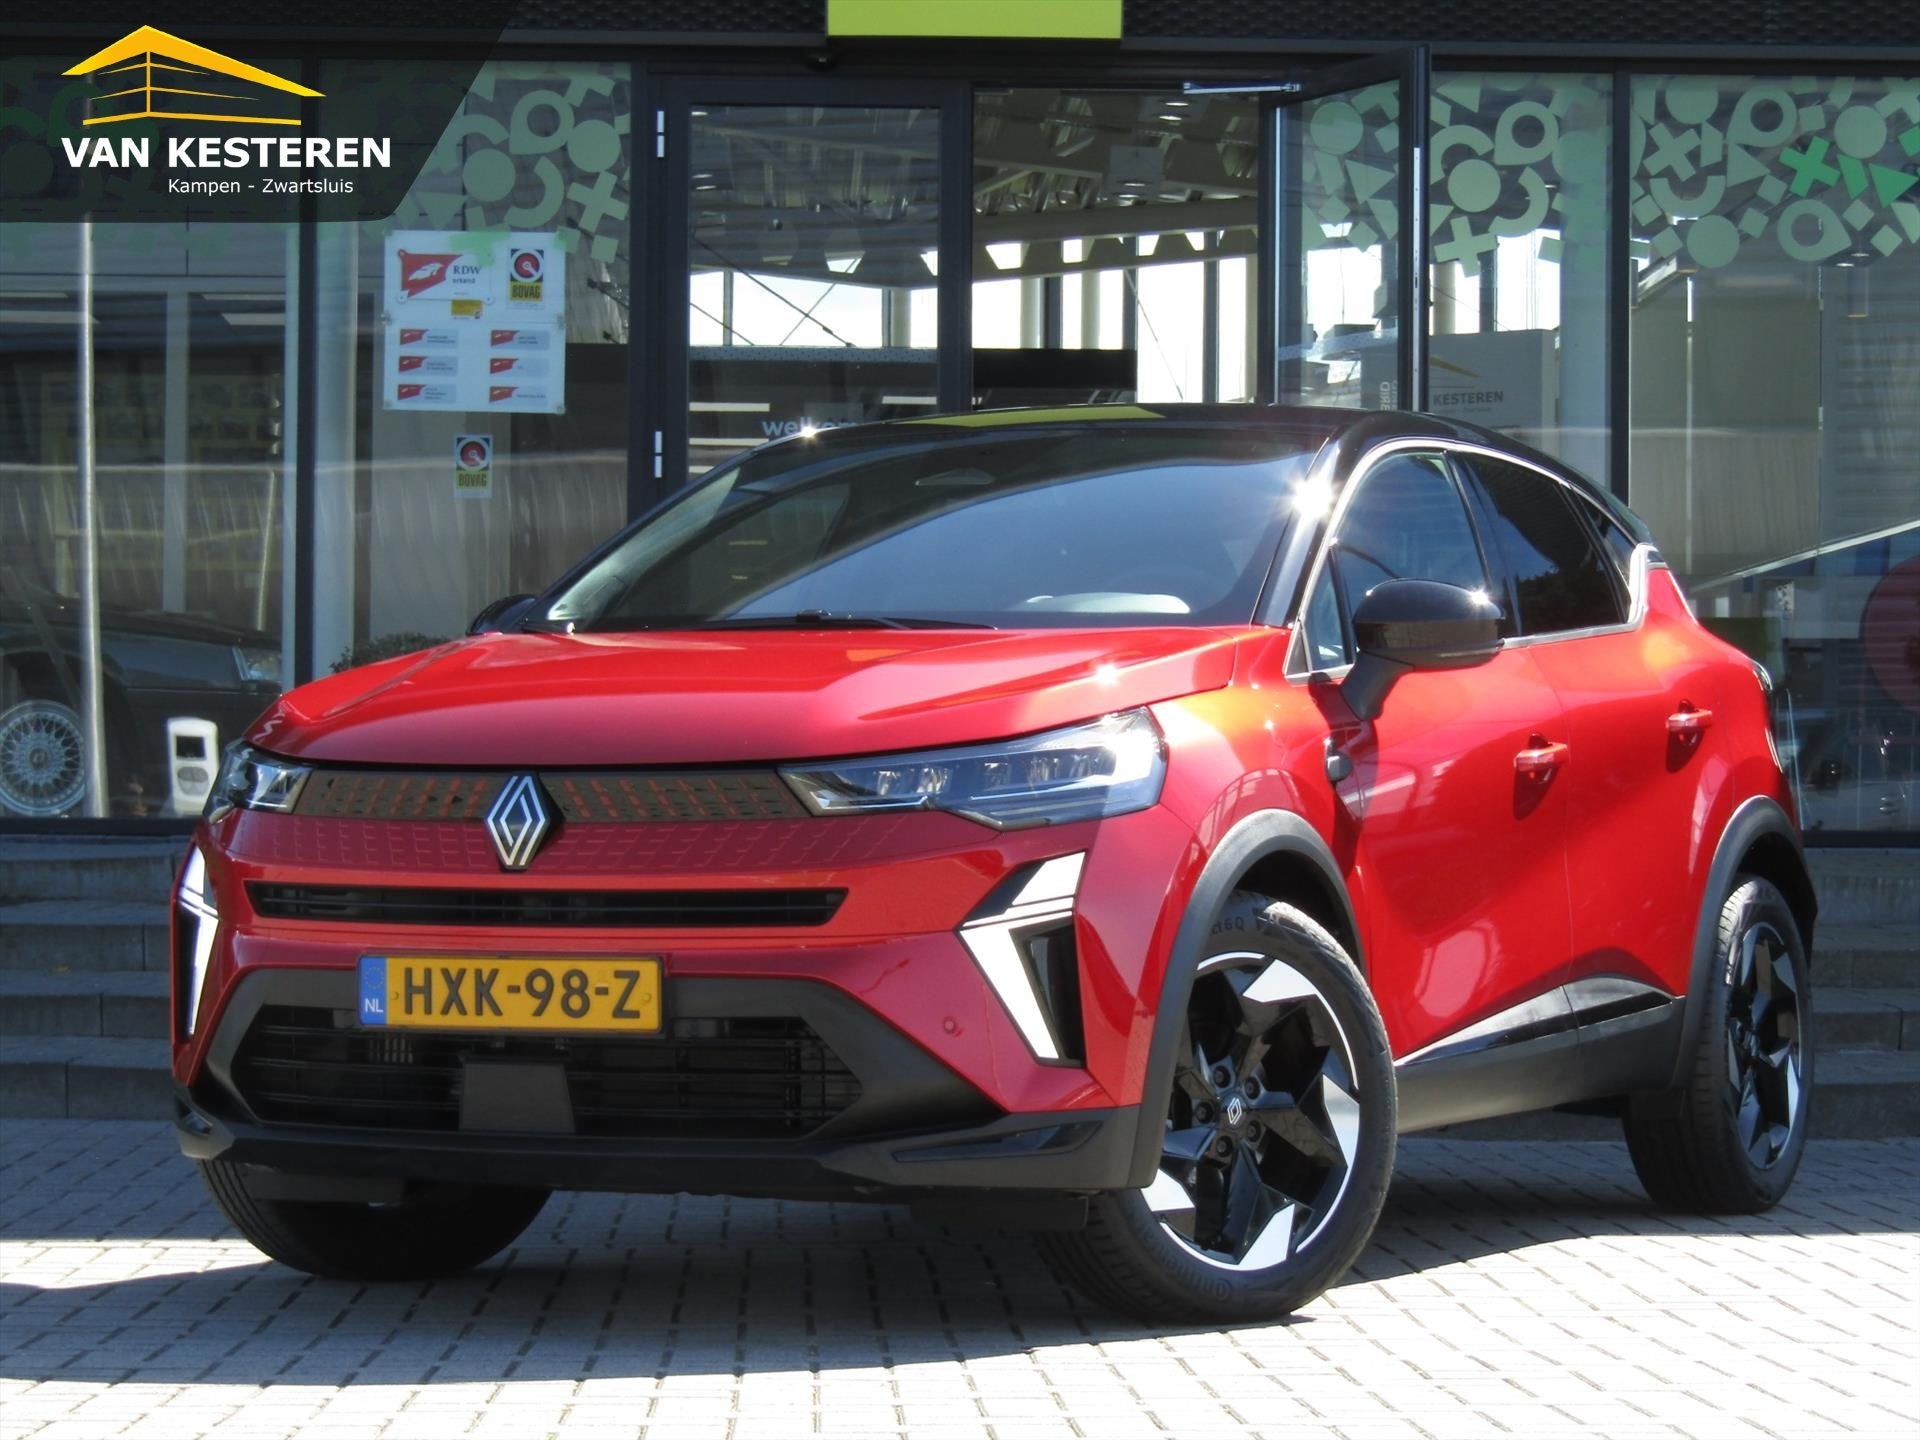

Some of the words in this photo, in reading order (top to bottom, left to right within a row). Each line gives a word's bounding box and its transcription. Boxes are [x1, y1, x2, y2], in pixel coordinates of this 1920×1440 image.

[453, 264, 482, 275] RDW
[511, 284, 542, 299] BOVAG
[1433, 390, 1504, 406] KESTEREN
[458, 472, 488, 488] BOVAG
[404, 966, 641, 1019] HXK-98-Z
[364, 998, 384, 1014] NL
